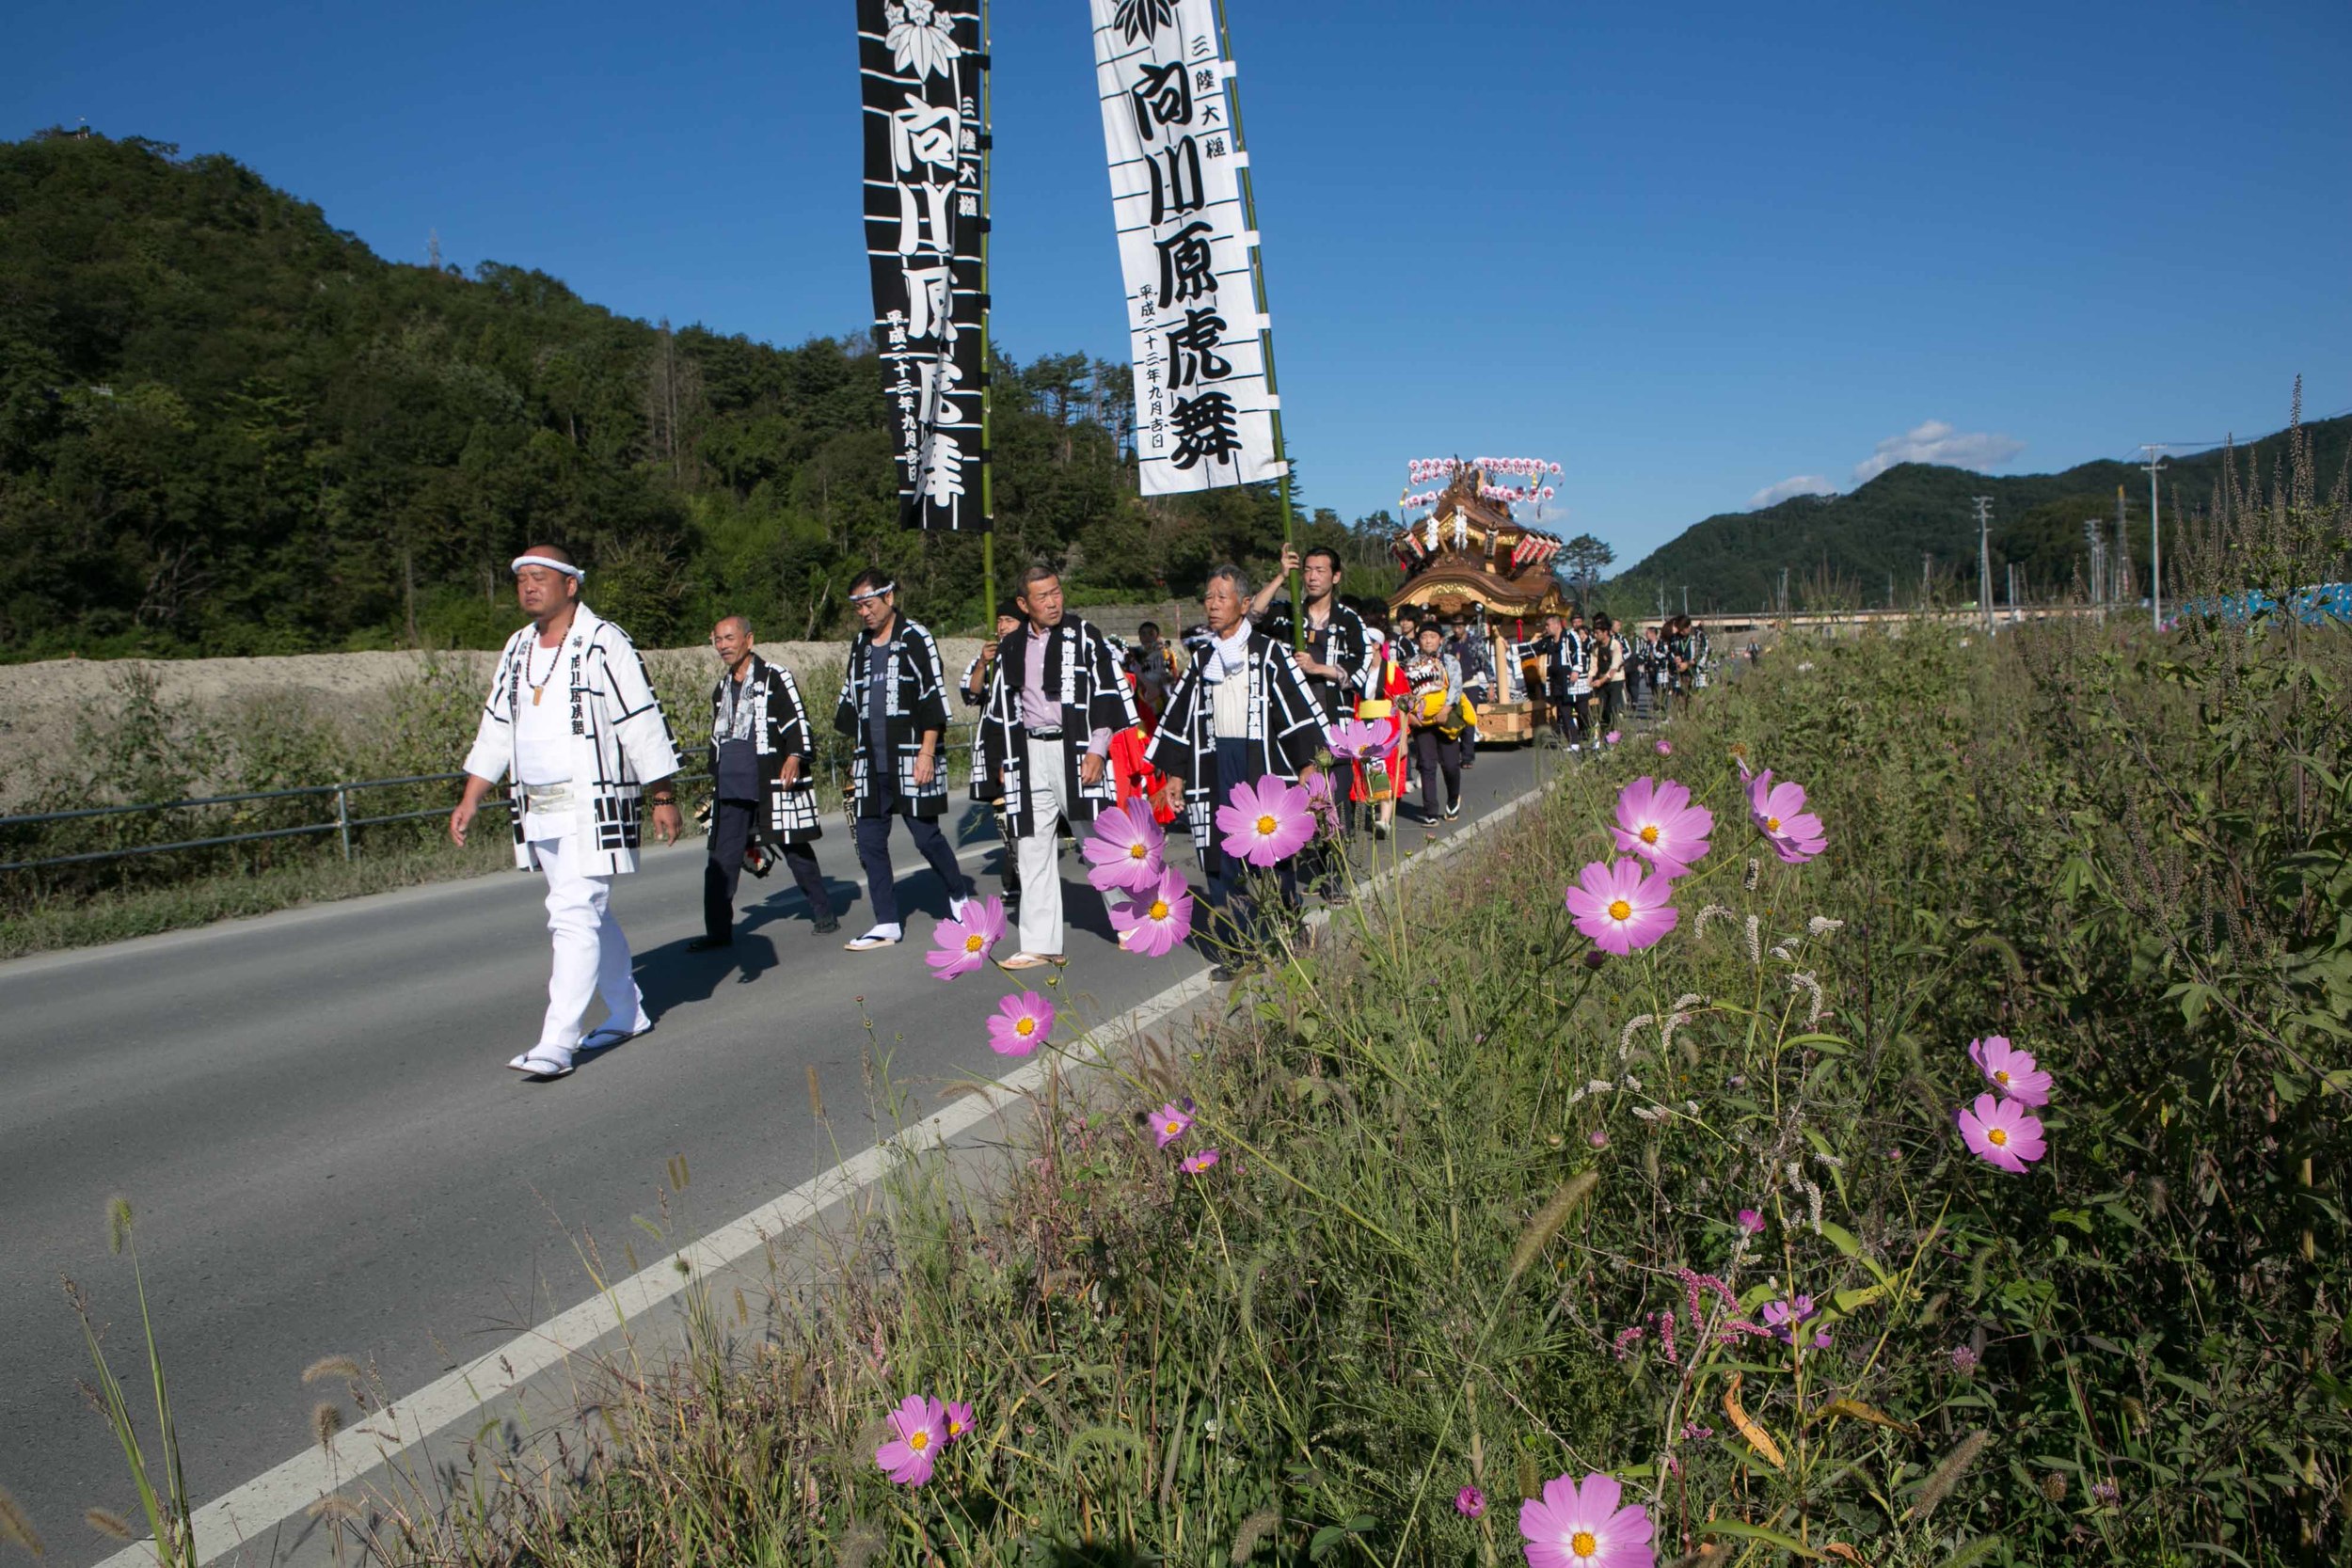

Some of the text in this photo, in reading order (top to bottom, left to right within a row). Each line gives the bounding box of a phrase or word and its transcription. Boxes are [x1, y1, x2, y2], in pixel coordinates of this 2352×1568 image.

[1130, 61, 1243, 471] 向川原虎舞
[1139, 284, 1165, 449] 平成二十三年九月吉日
